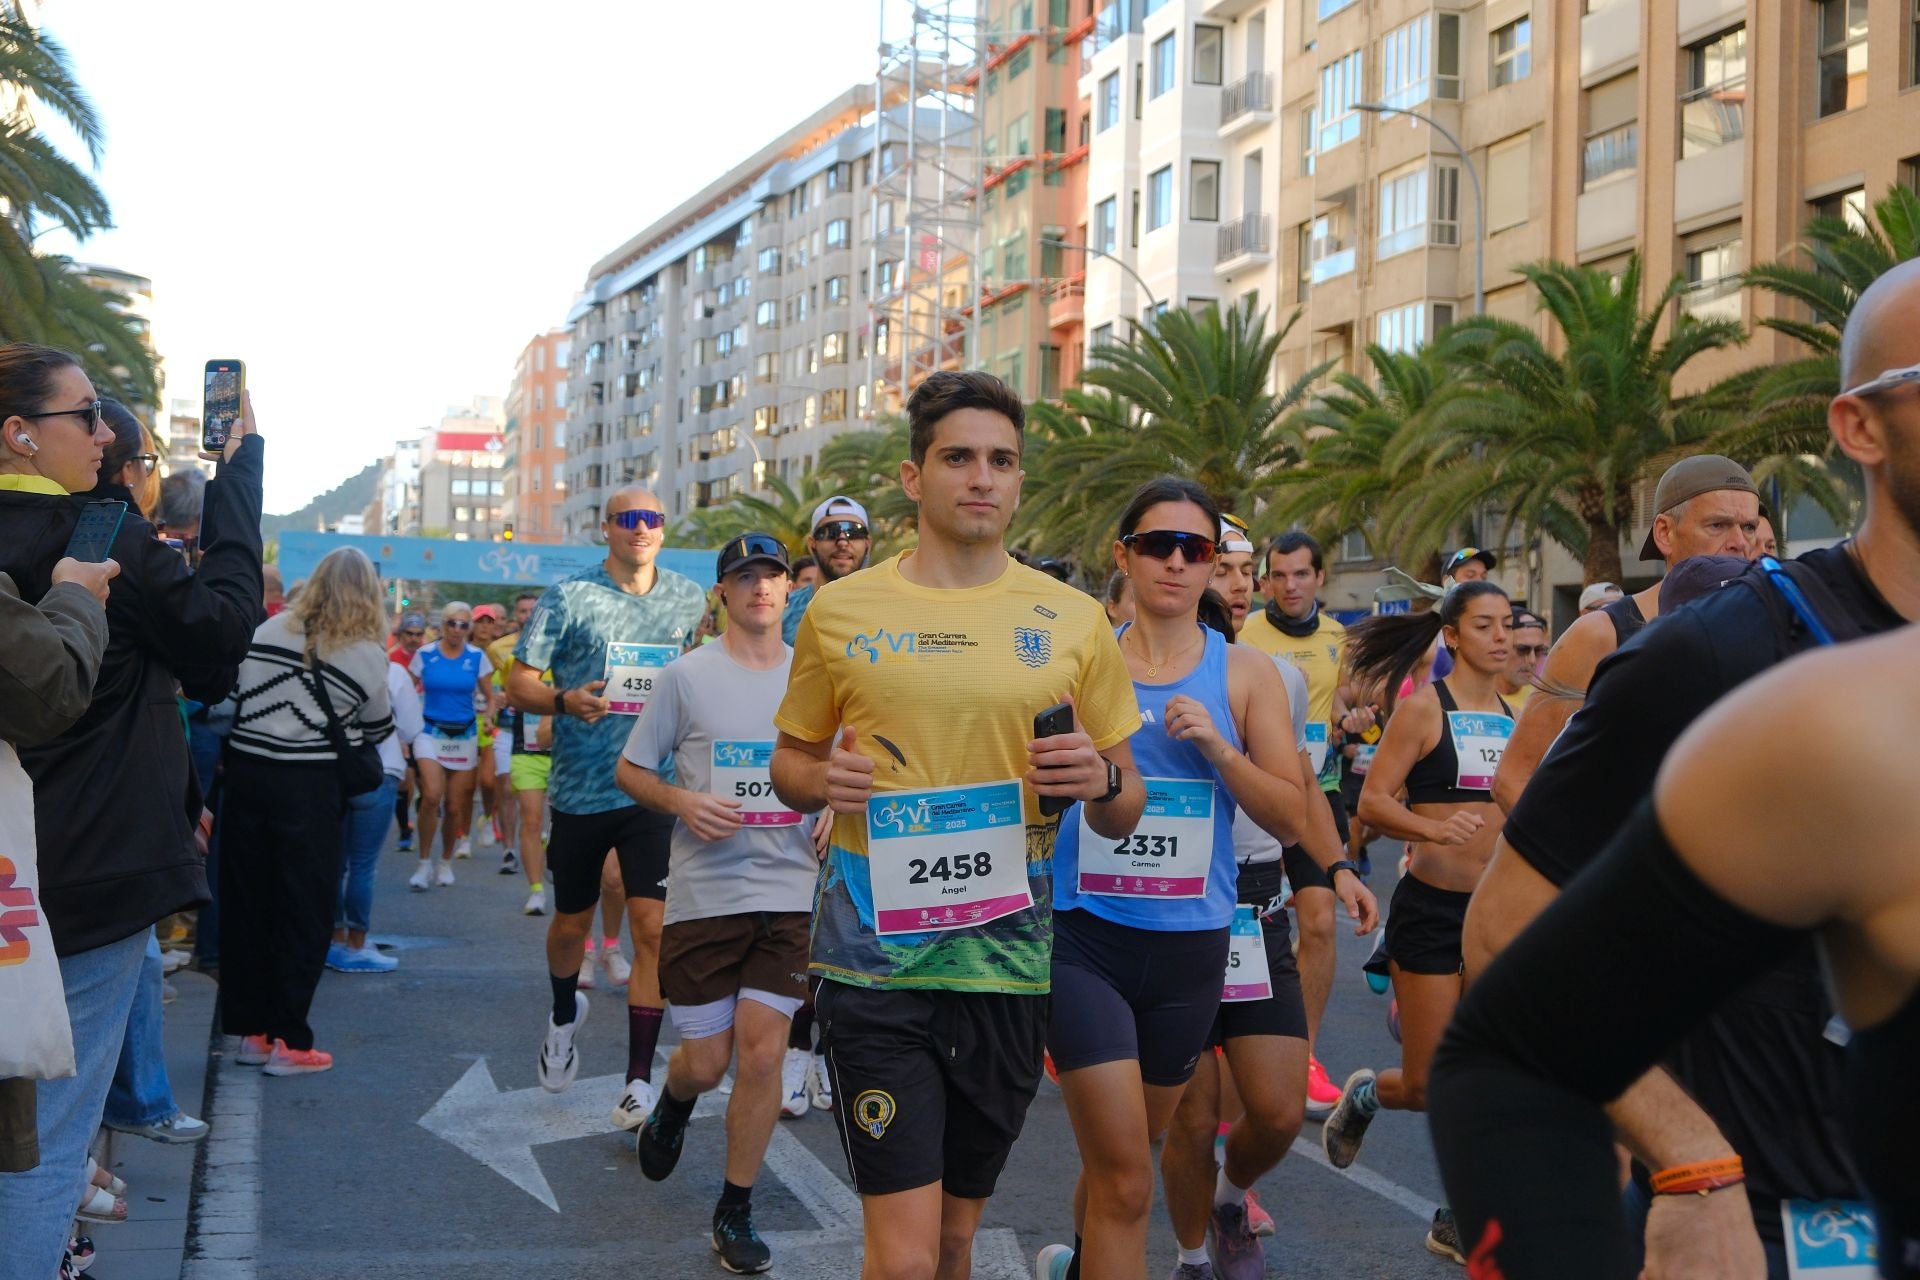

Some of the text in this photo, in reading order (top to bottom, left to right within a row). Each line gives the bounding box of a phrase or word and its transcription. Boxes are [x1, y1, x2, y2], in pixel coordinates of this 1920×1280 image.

[886, 632, 915, 653] VI
[938, 632, 967, 640] Carrera
[735, 781, 773, 798] 507
[907, 804, 931, 824] VI
[945, 819, 967, 830] 2025
[1113, 834, 1178, 857] 2331
[908, 851, 992, 885] 2458
[1131, 860, 1161, 868] Carmen
[941, 885, 967, 895] Ángel
